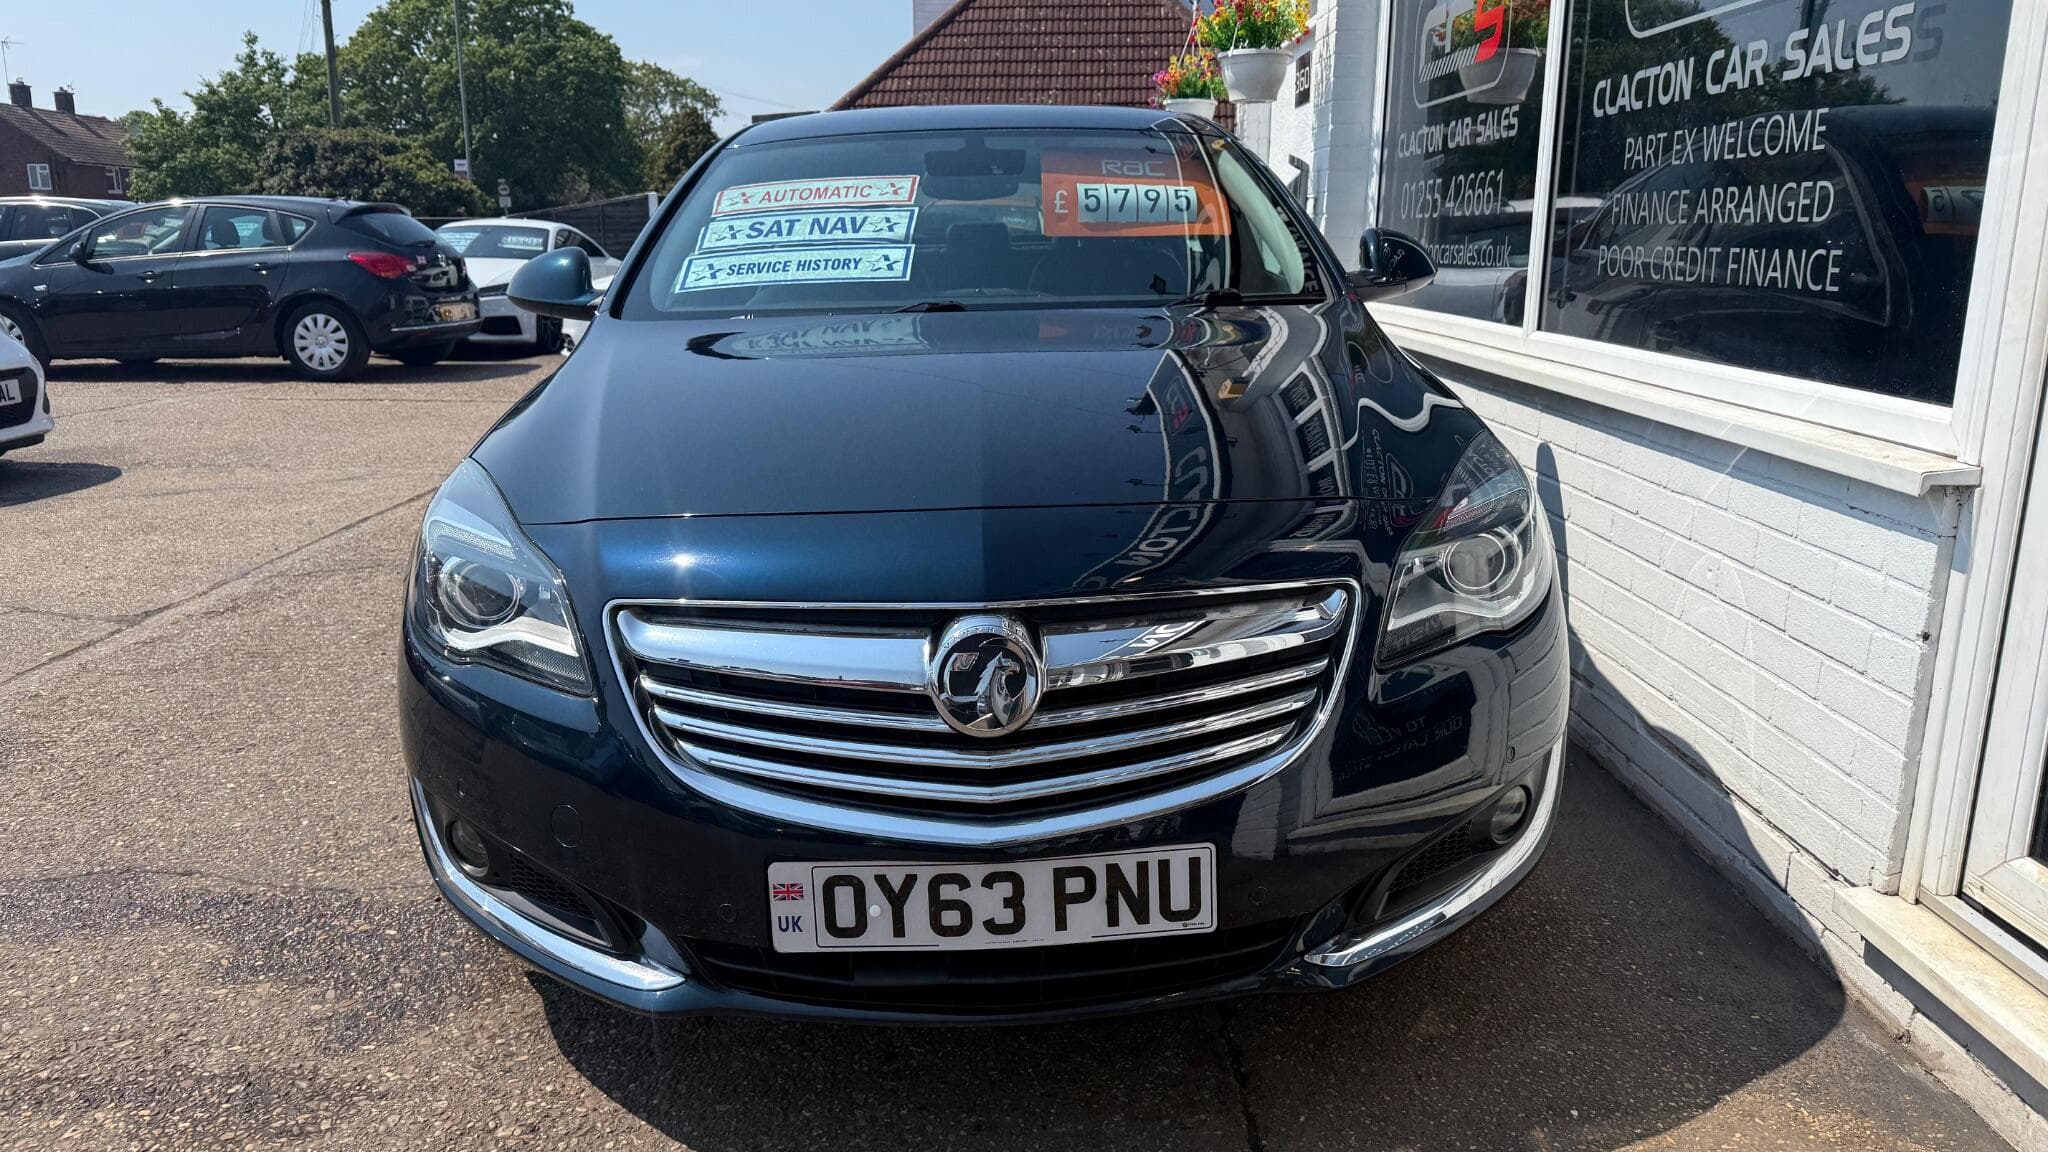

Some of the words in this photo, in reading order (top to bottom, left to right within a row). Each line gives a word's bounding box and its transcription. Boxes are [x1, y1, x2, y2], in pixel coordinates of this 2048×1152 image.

[1592, 57, 1696, 119] CLACTON
[1705, 39, 1769, 96] CAR
[1782, 2, 1917, 82] SALES
[1398, 123, 1444, 158] CLACTON
[1448, 116, 1472, 149] CAR
[1475, 104, 1520, 144] SALES
[1623, 132, 1668, 170] PART
[1671, 127, 1698, 166] EX
[1702, 107, 1830, 162] WELCOME
[758, 184, 874, 204] AUTOMATIC
[1400, 178, 1443, 219] 01255
[1444, 168, 1505, 217] 426661
[1611, 188, 1690, 225] FINANCE
[1693, 180, 1835, 225] ARRANGED
[745, 218, 801, 240] SAT
[808, 215, 870, 236] NAV
[726, 260, 792, 277] SERVICE
[796, 257, 863, 272] HISTORY
[1426, 235, 1512, 268] oncarsales.co.uk
[1597, 245, 1645, 278] POOR
[1650, 246, 1722, 284] CREDIT
[1725, 247, 1844, 292] FINANCE
[822, 870, 1027, 939] OY63
[1052, 856, 1202, 932] PNU
[777, 915, 803, 933] UK
